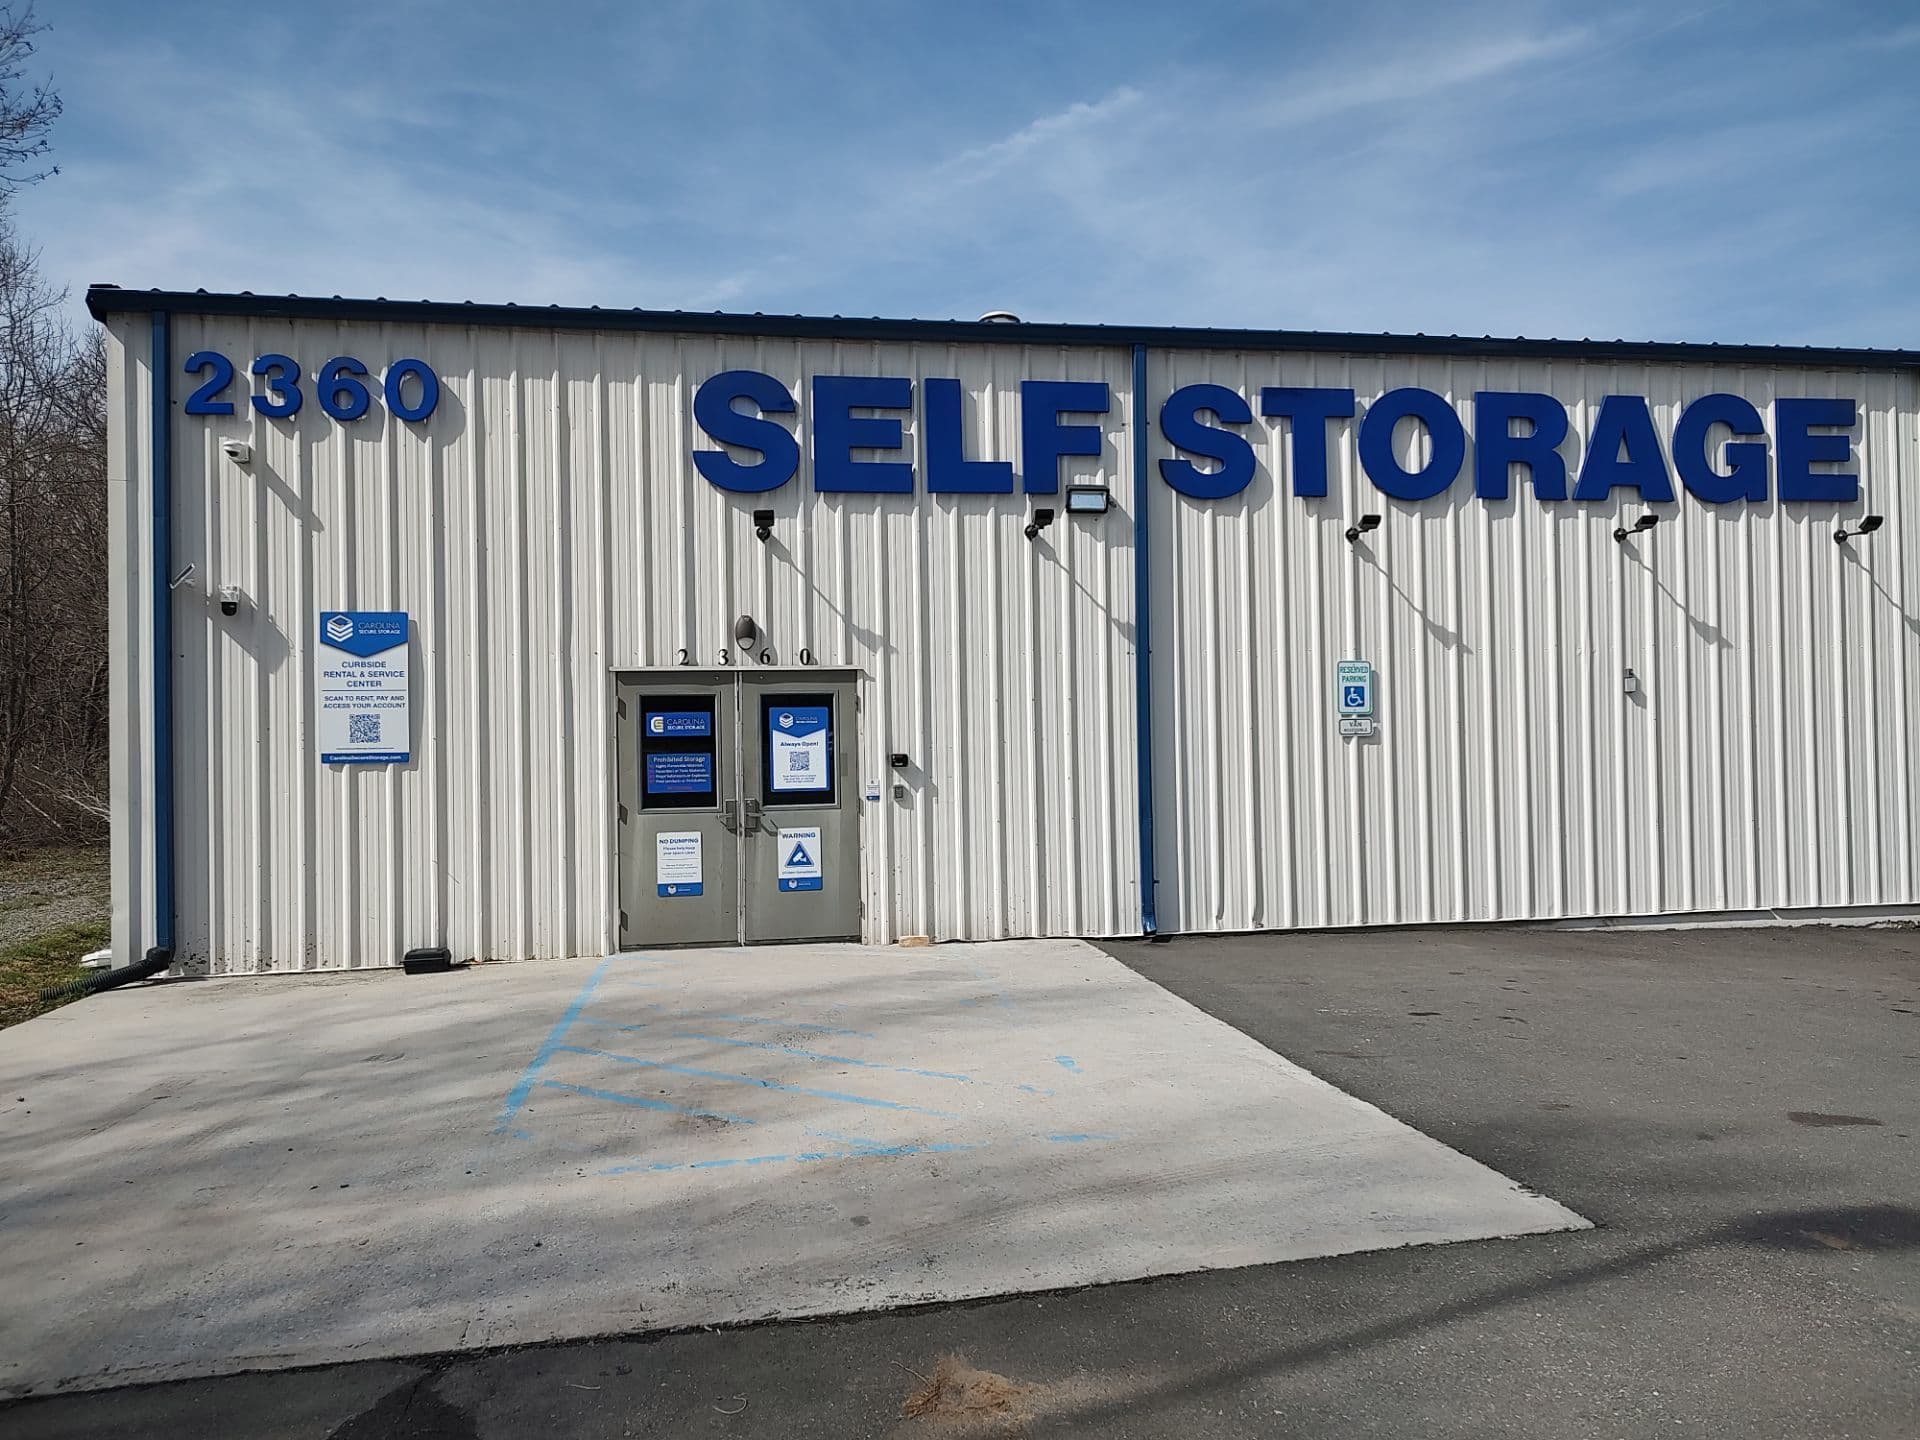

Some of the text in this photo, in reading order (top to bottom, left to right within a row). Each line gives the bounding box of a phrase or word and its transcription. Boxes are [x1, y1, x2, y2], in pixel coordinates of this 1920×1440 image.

[184, 351, 439, 421] 2360
[693, 370, 1860, 505] SELF STORAGE
[368, 670, 405, 678] SERVICE
[1339, 666, 1369, 674] RESERVED
[1341, 675, 1367, 683] PARKING
[666, 718, 705, 726] CAROLINA
